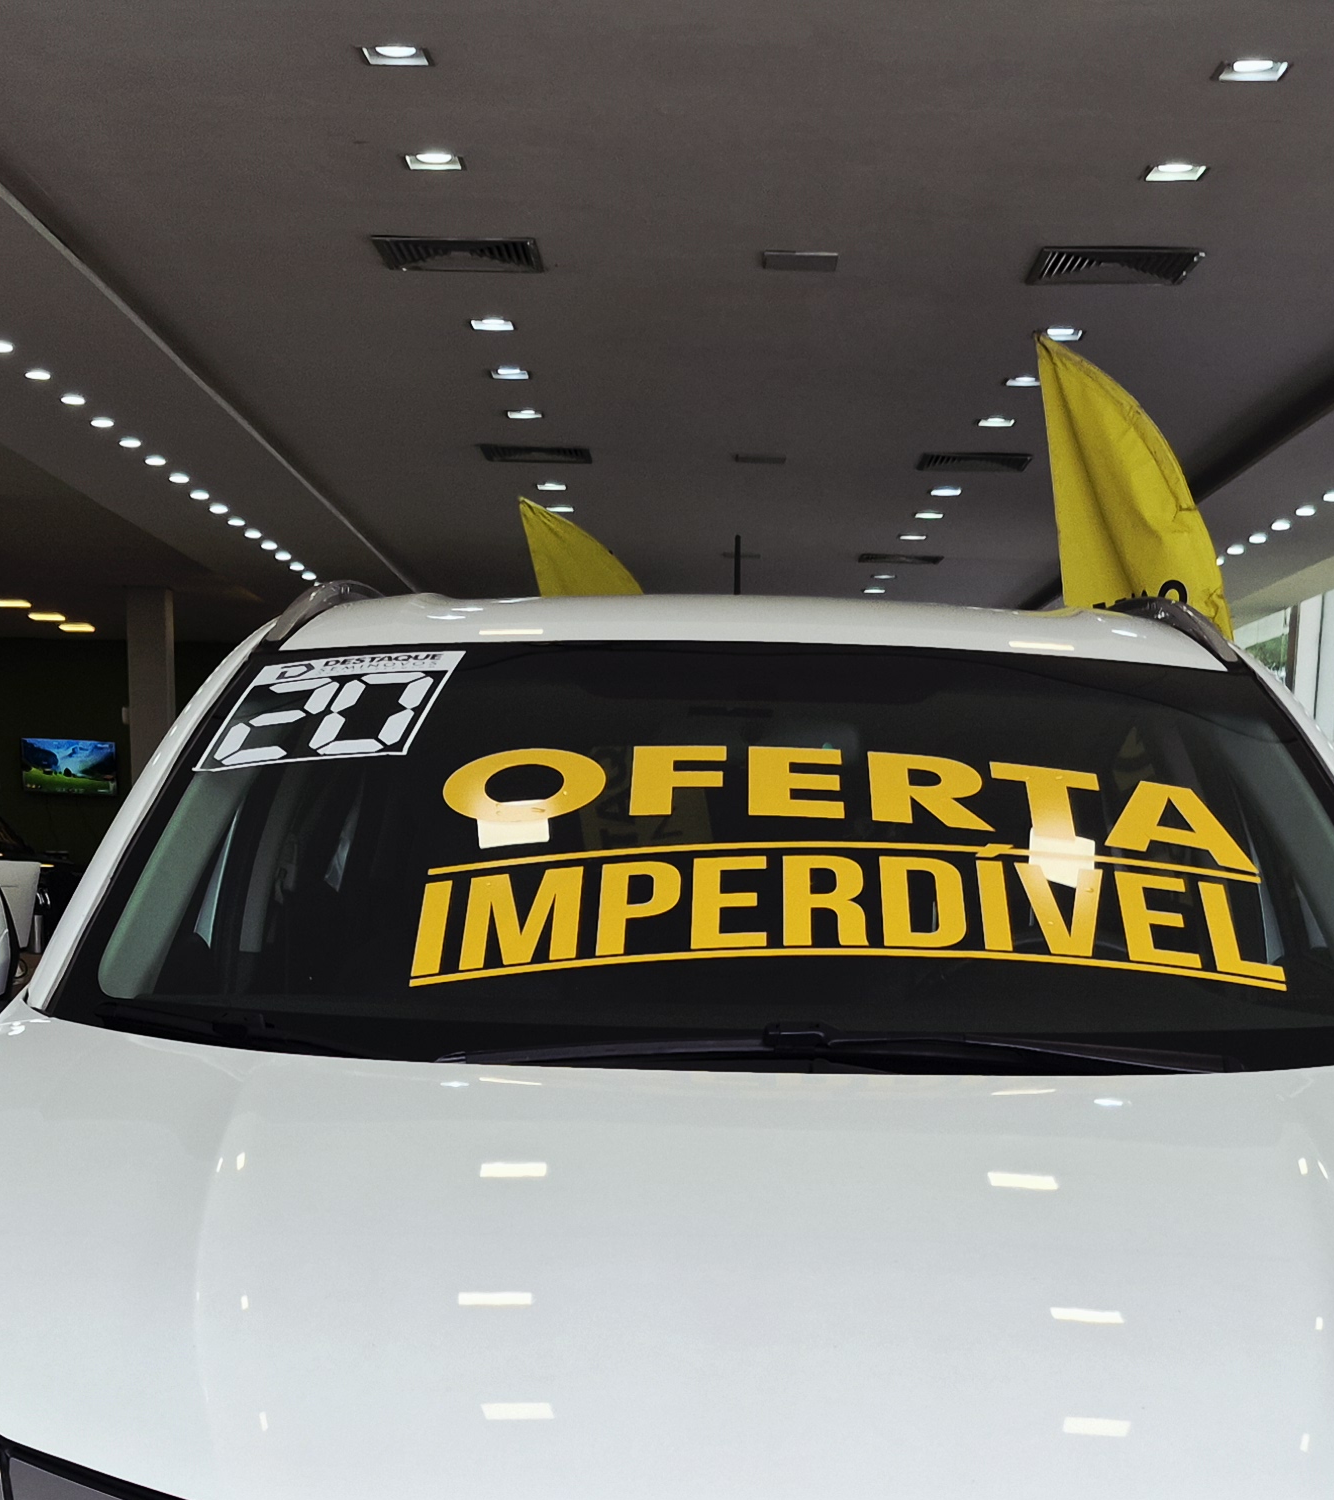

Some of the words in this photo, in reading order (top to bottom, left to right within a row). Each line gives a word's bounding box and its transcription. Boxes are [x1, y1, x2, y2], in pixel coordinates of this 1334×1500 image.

[323, 653, 444, 667] DESTAQUE
[214, 671, 434, 766] 20
[443, 745, 1258, 870] OFERTA
[410, 844, 1287, 981] IMPERDÍVEL
